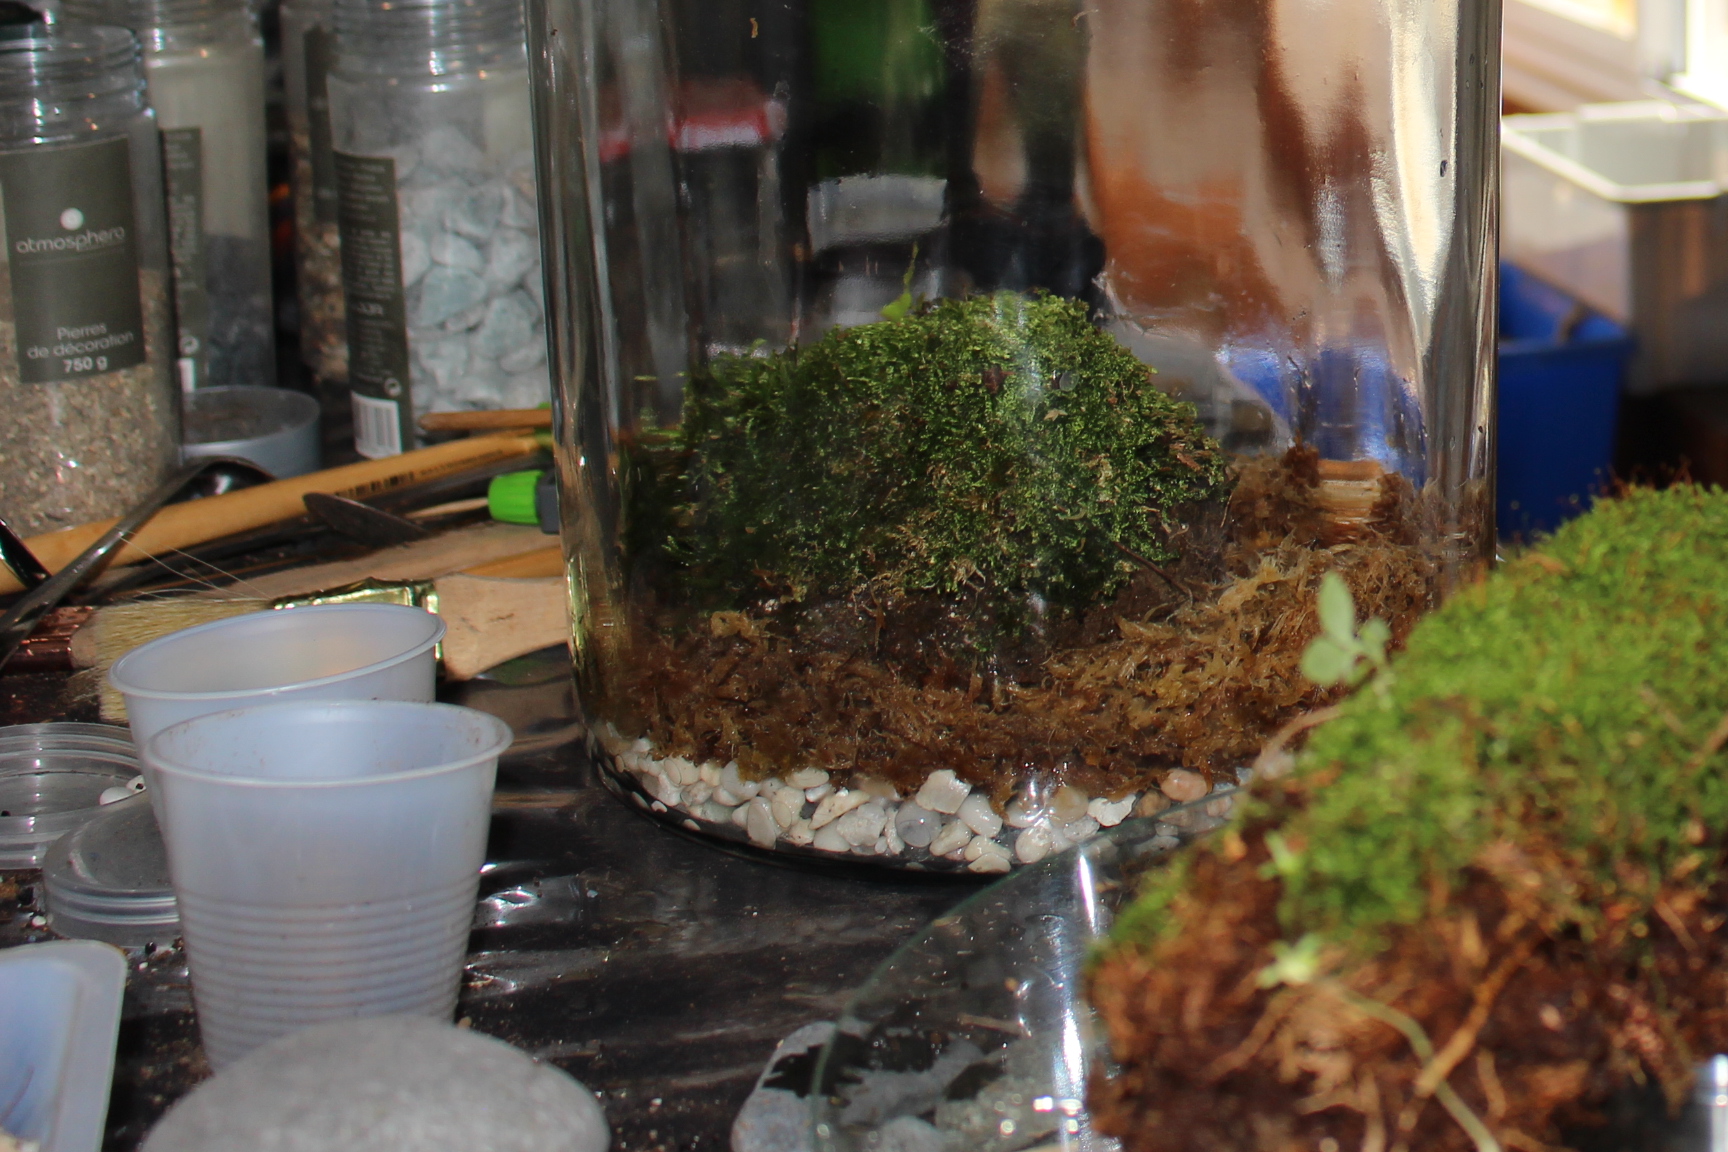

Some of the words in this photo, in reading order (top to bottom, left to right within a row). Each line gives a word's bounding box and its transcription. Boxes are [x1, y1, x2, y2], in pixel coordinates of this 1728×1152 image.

[56, 323, 107, 340] Pierres
[27, 346, 49, 359] de
[53, 331, 134, 357] décoration
[63, 356, 93, 373] 750
[96, 356, 108, 371] g
